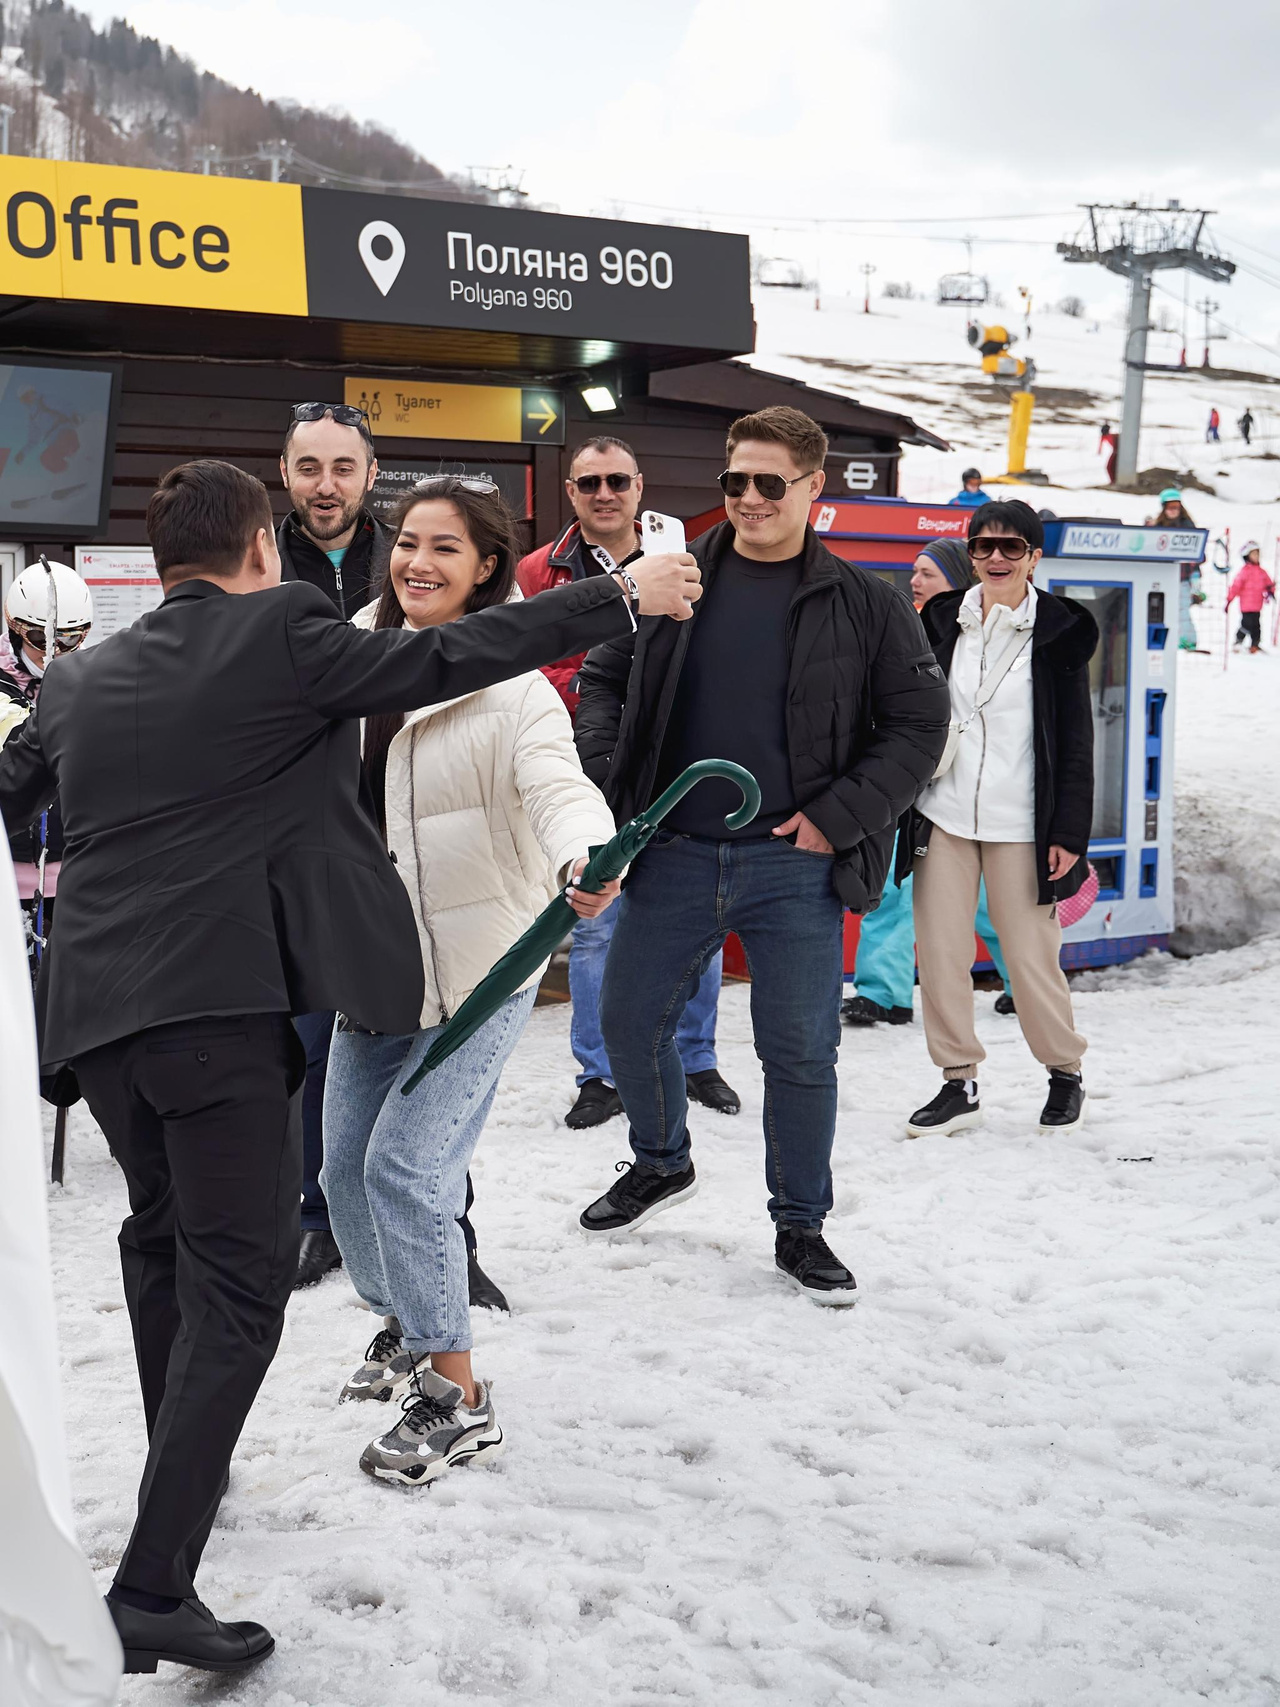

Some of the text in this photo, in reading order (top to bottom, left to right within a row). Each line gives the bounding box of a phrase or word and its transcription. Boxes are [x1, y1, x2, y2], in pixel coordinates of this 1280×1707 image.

[7, 191, 231, 273] Office
[447, 231, 673, 290] Поляна 960
[450, 280, 573, 311] Polyana 960
[395, 393, 442, 411] Туалет
[395, 413, 410, 423] WC
[373, 485, 406, 495] Rescue
[917, 516, 962, 533] Вендинг
[1068, 531, 1120, 549] МАСКИ
